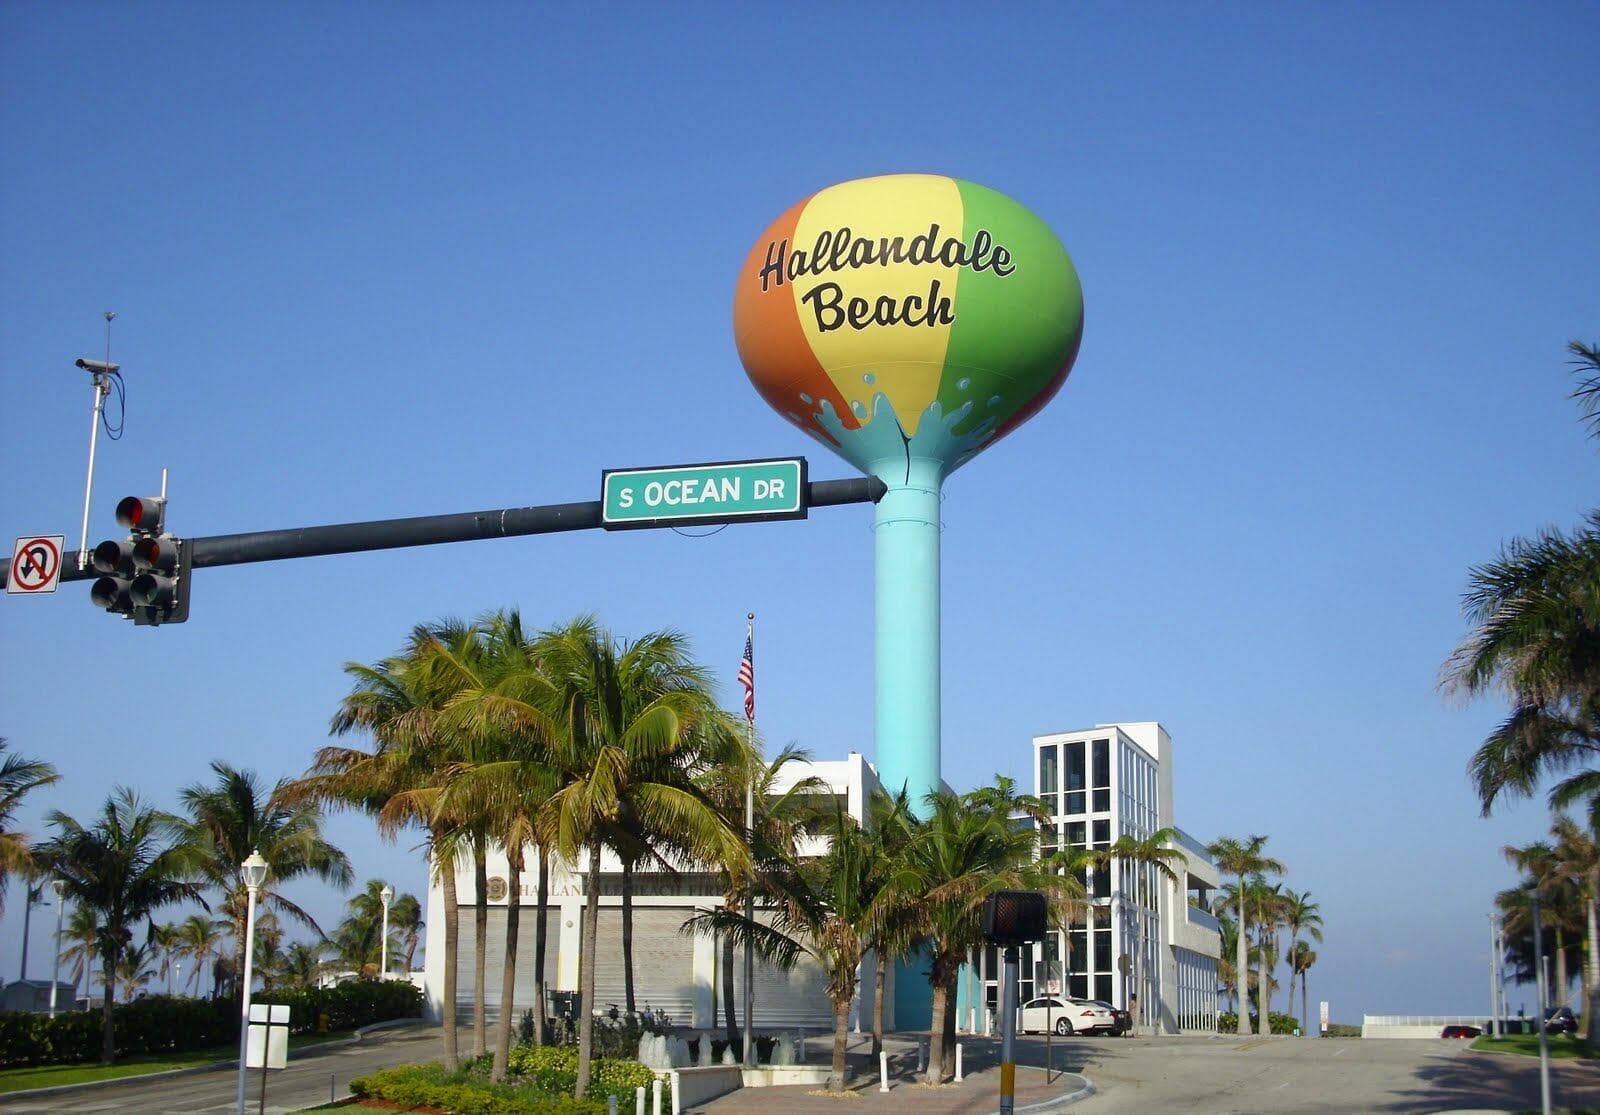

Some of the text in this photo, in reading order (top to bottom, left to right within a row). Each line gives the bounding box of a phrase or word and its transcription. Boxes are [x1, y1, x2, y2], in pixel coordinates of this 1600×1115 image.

[759, 222, 1016, 292] Hallandale
[801, 279, 955, 333] Beach
[619, 476, 785, 508] S OCEAN DR
